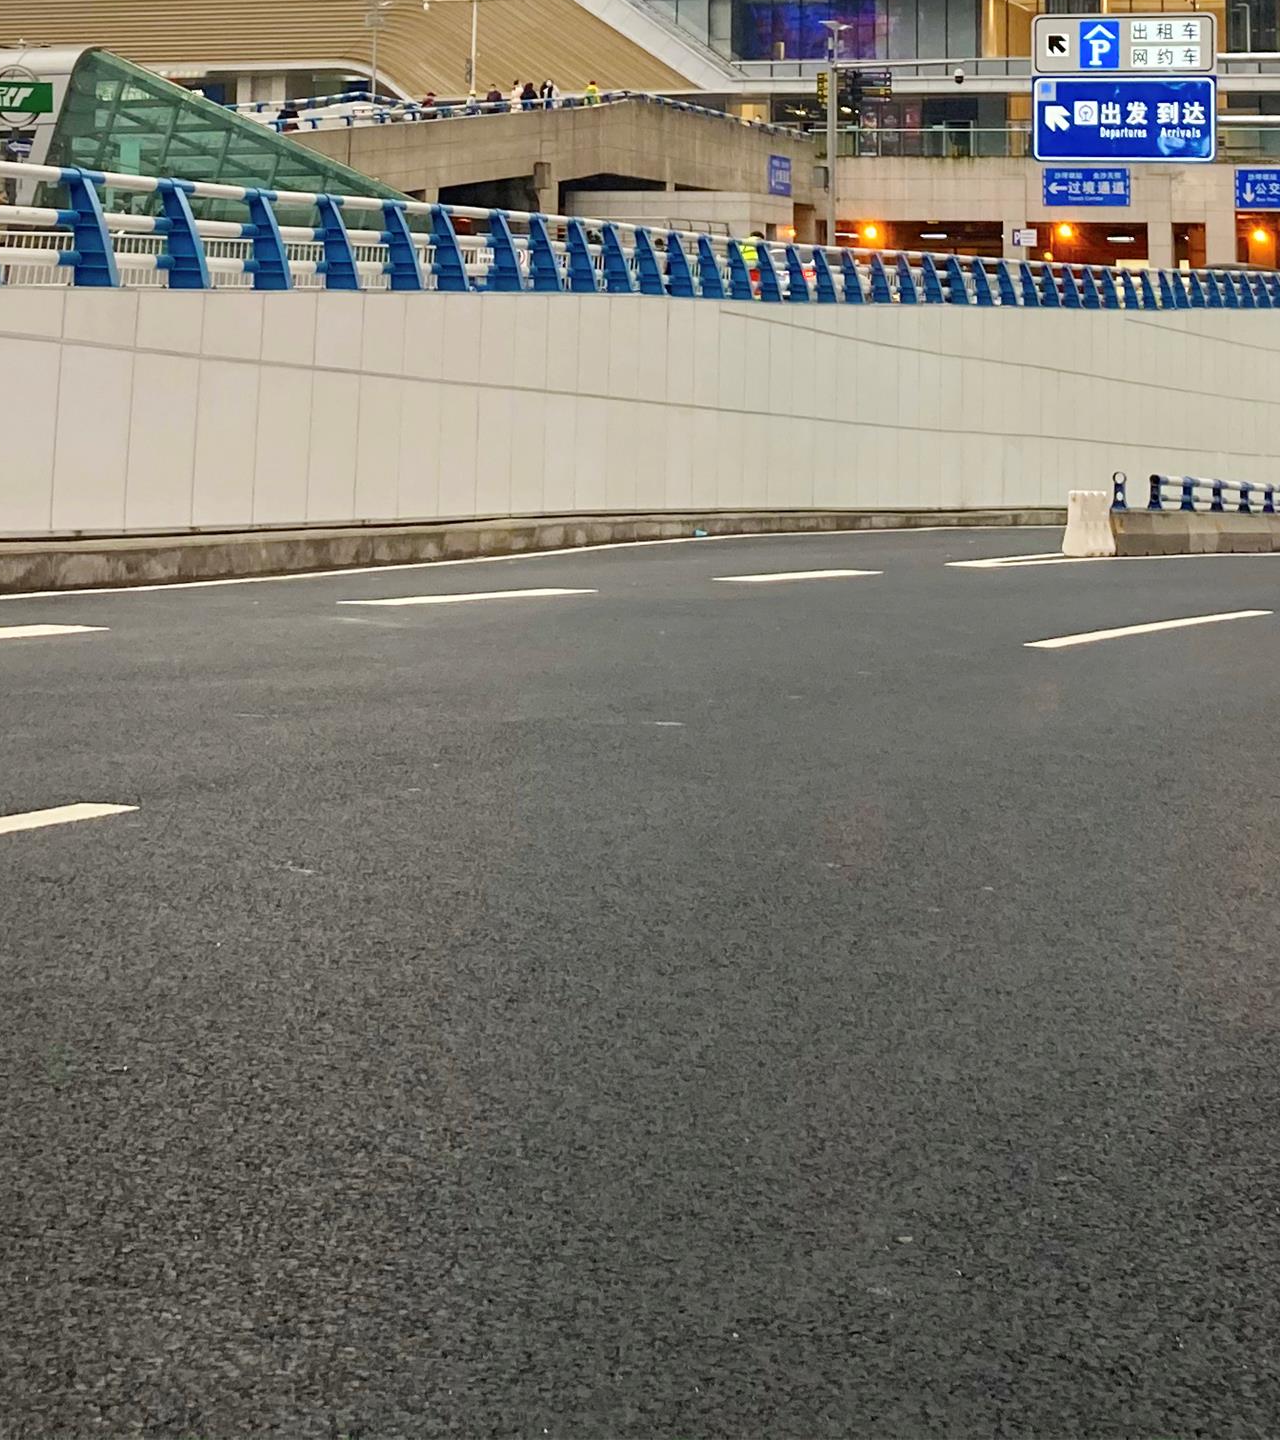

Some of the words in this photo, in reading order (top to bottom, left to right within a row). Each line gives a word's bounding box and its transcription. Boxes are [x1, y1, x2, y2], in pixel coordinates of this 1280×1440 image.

[1132, 22, 1199, 40] 出租车
[1089, 40, 1111, 66] P
[1132, 48, 1199, 65] 网约车
[1100, 101, 1148, 125] 出发
[1156, 101, 1206, 125] 到达
[1100, 127, 1147, 139] Departures
[1160, 127, 1201, 138] Arrivals
[1068, 181, 1126, 195] 过境通道
